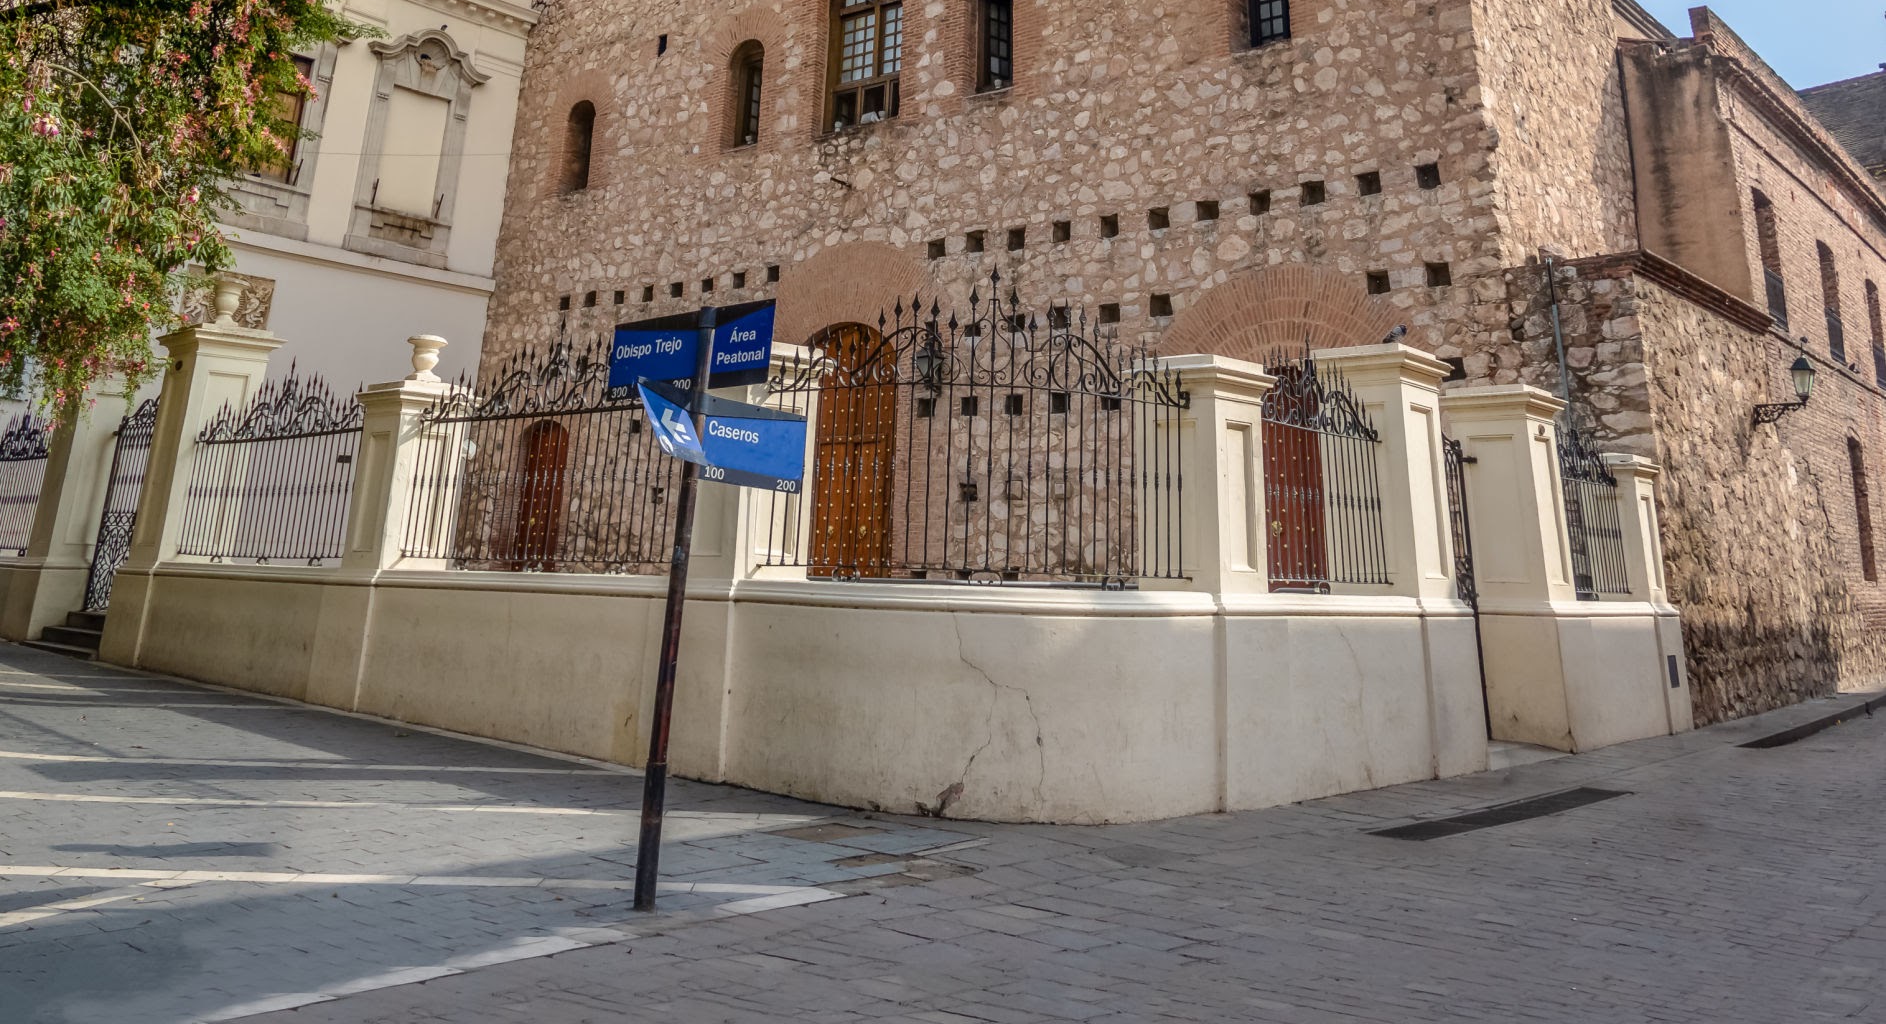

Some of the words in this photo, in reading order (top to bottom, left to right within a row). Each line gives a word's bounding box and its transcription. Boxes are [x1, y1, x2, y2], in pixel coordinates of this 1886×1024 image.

[730, 326, 757, 344] Área
[616, 345, 652, 360] Obispo
[656, 336, 682, 355] Trejo
[716, 346, 765, 365] Peatonal
[611, 386, 628, 398] 300
[709, 420, 759, 444] Caseros
[704, 466, 725, 480] 100
[776, 479, 796, 492] 200
